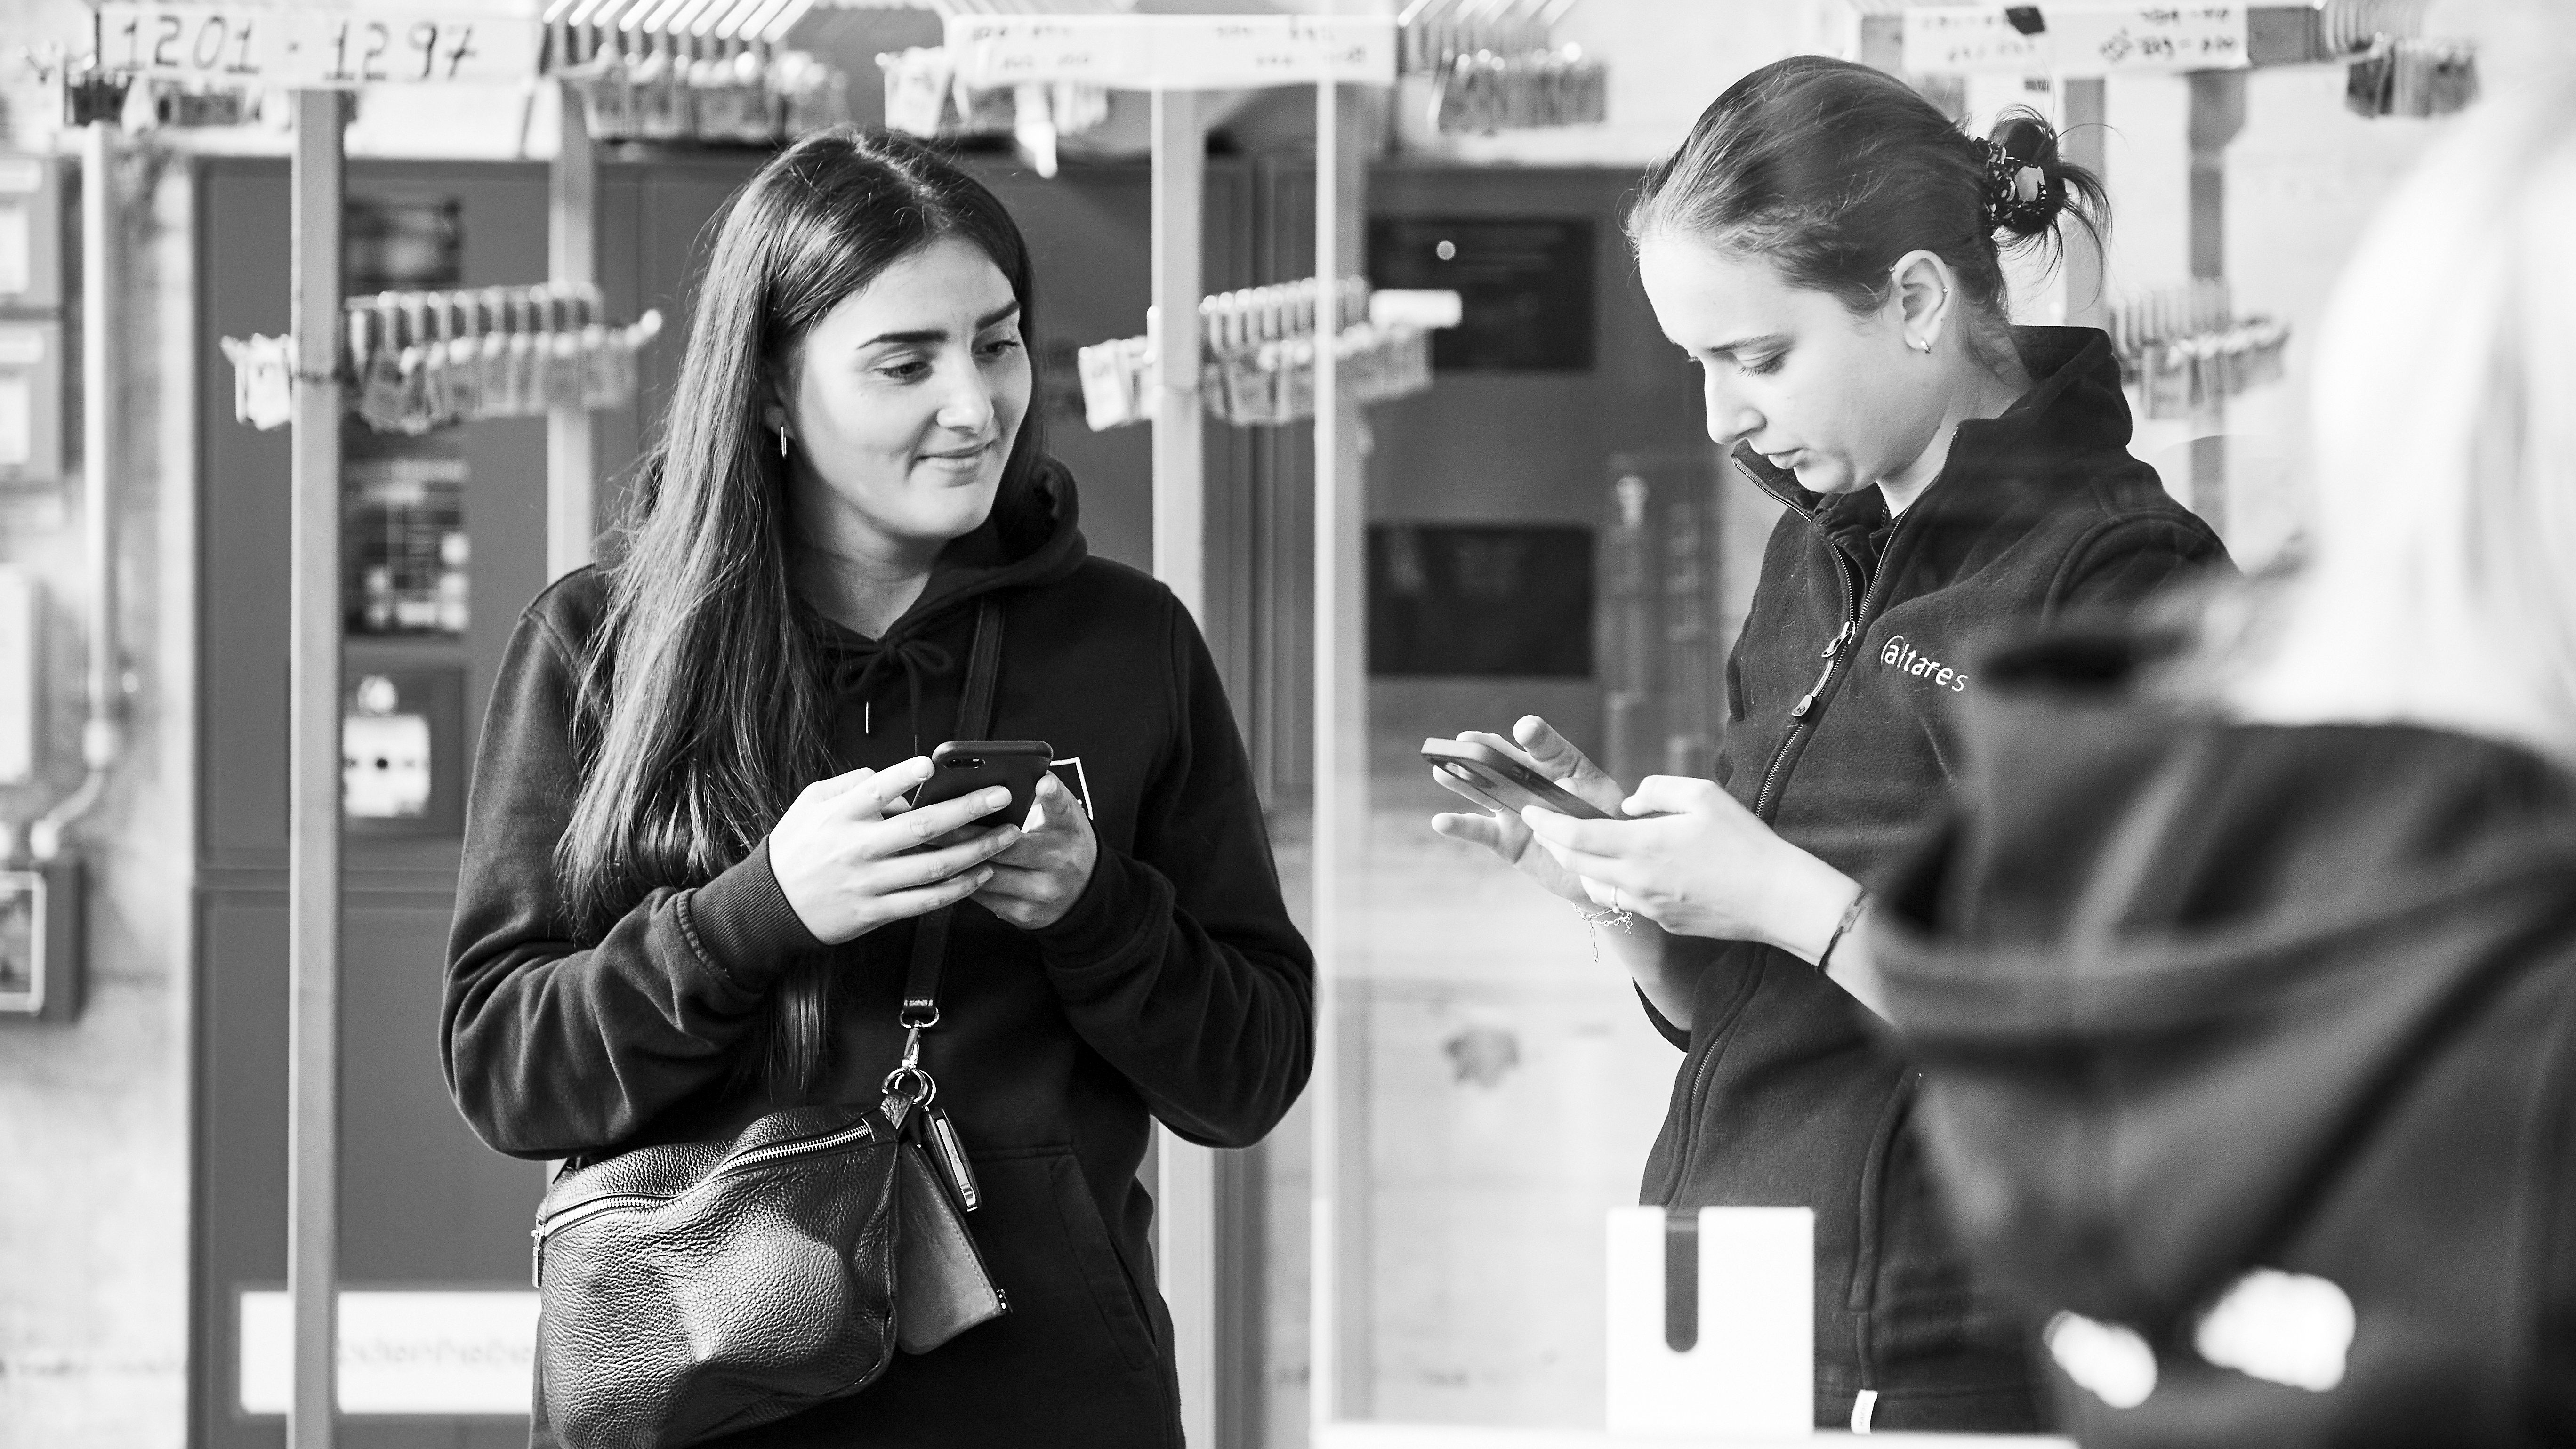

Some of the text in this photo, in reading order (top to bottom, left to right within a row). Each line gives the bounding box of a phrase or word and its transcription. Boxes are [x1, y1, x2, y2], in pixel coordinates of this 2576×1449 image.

[116, 14, 261, 74] 1201
[324, 20, 478, 81] 1297
[1884, 643, 1968, 692] altares
